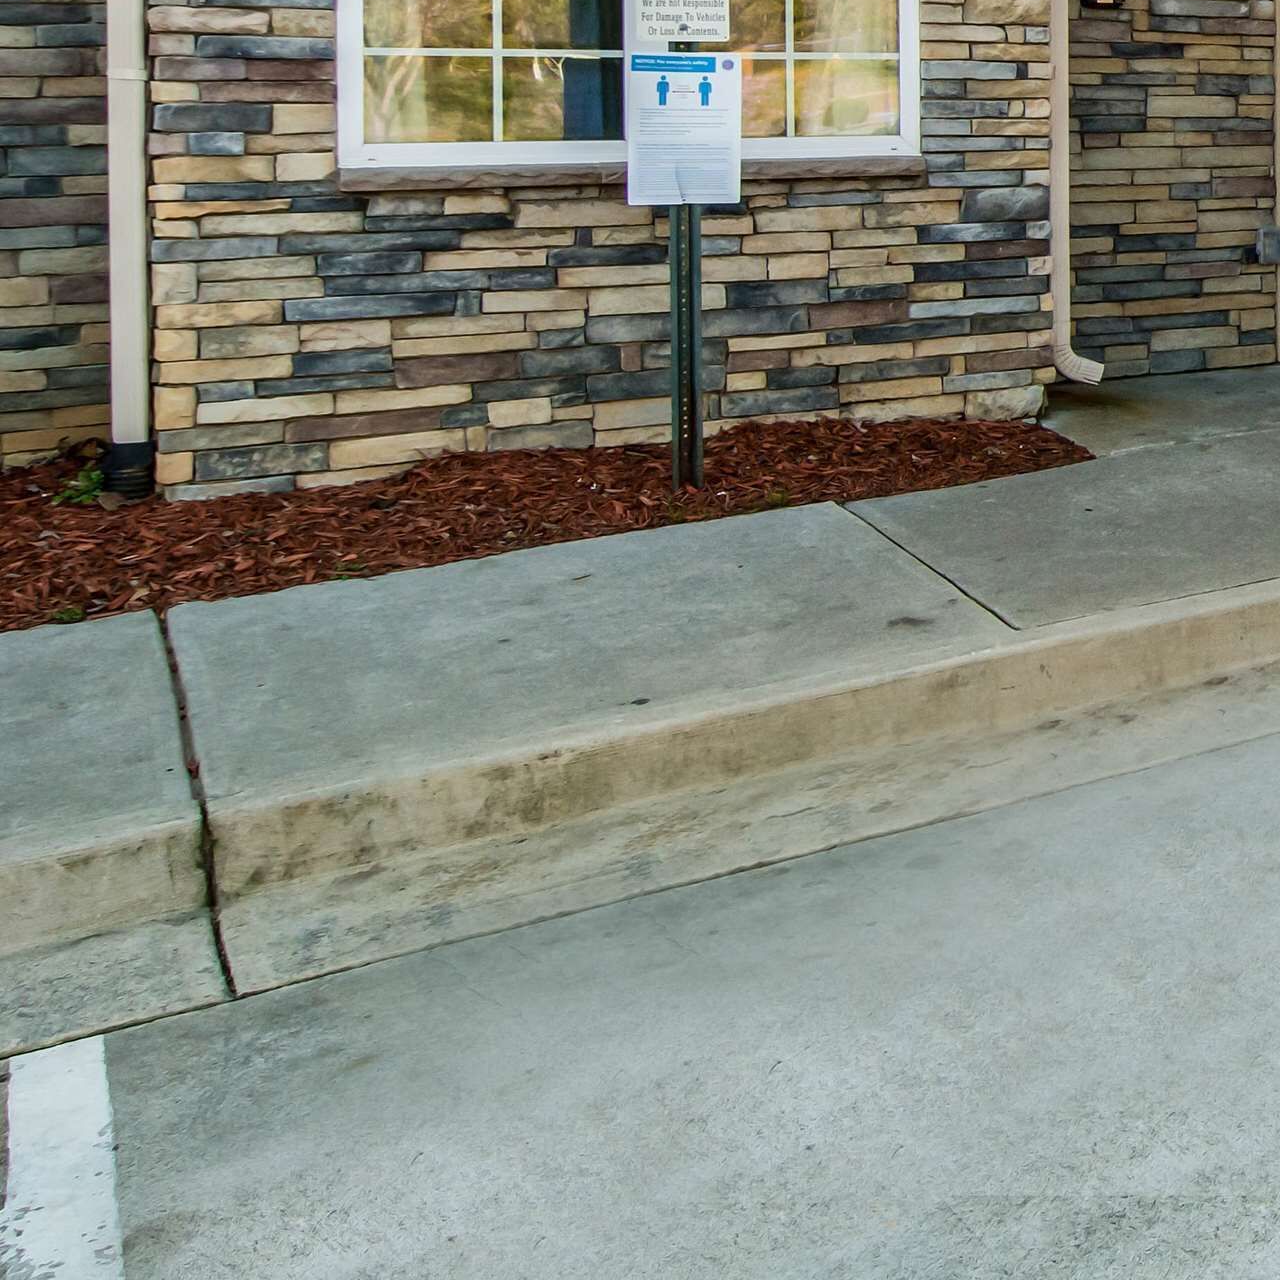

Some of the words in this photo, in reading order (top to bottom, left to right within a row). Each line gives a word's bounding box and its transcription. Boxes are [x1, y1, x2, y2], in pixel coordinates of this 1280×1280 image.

[641, 12, 653, 21] For
[655, 12, 682, 23] Damage
[685, 12, 695, 21] To
[696, 12, 726, 22] Vehicles
[648, 26, 657, 35] Or
[659, 26, 675, 35] Loss
